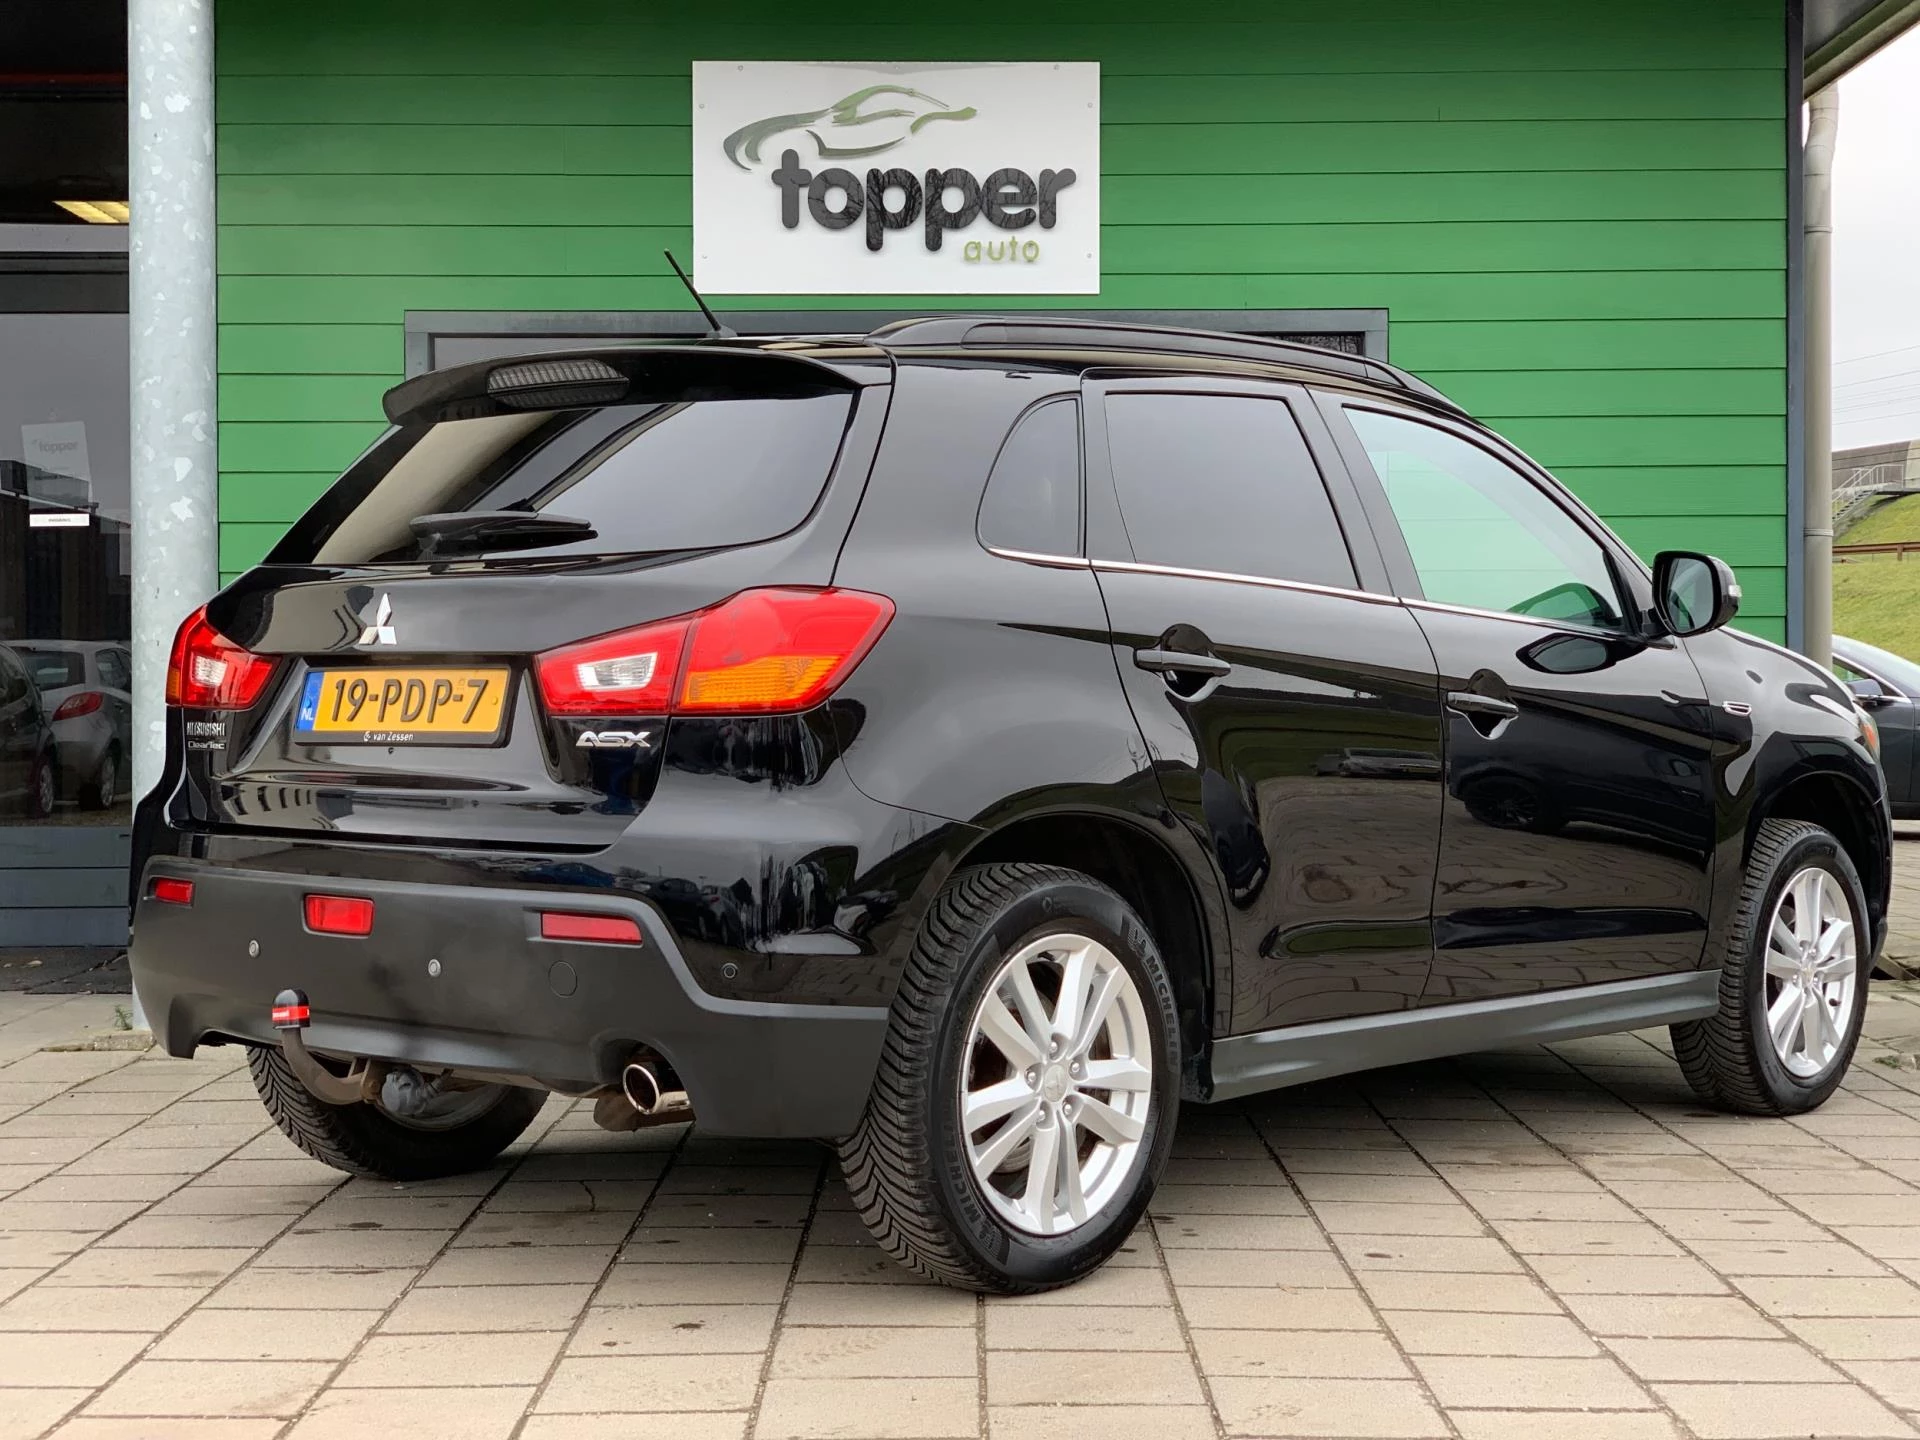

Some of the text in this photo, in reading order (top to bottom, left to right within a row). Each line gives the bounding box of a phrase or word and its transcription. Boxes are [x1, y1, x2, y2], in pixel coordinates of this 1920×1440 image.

[771, 148, 1077, 252] topper
[963, 235, 1040, 262] auto
[331, 678, 489, 724] 19-PDP-7
[300, 707, 314, 721] NL
[186, 721, 226, 737] MITSUBISHI
[373, 731, 414, 741] van Zessen
[575, 730, 652, 748] ASX
